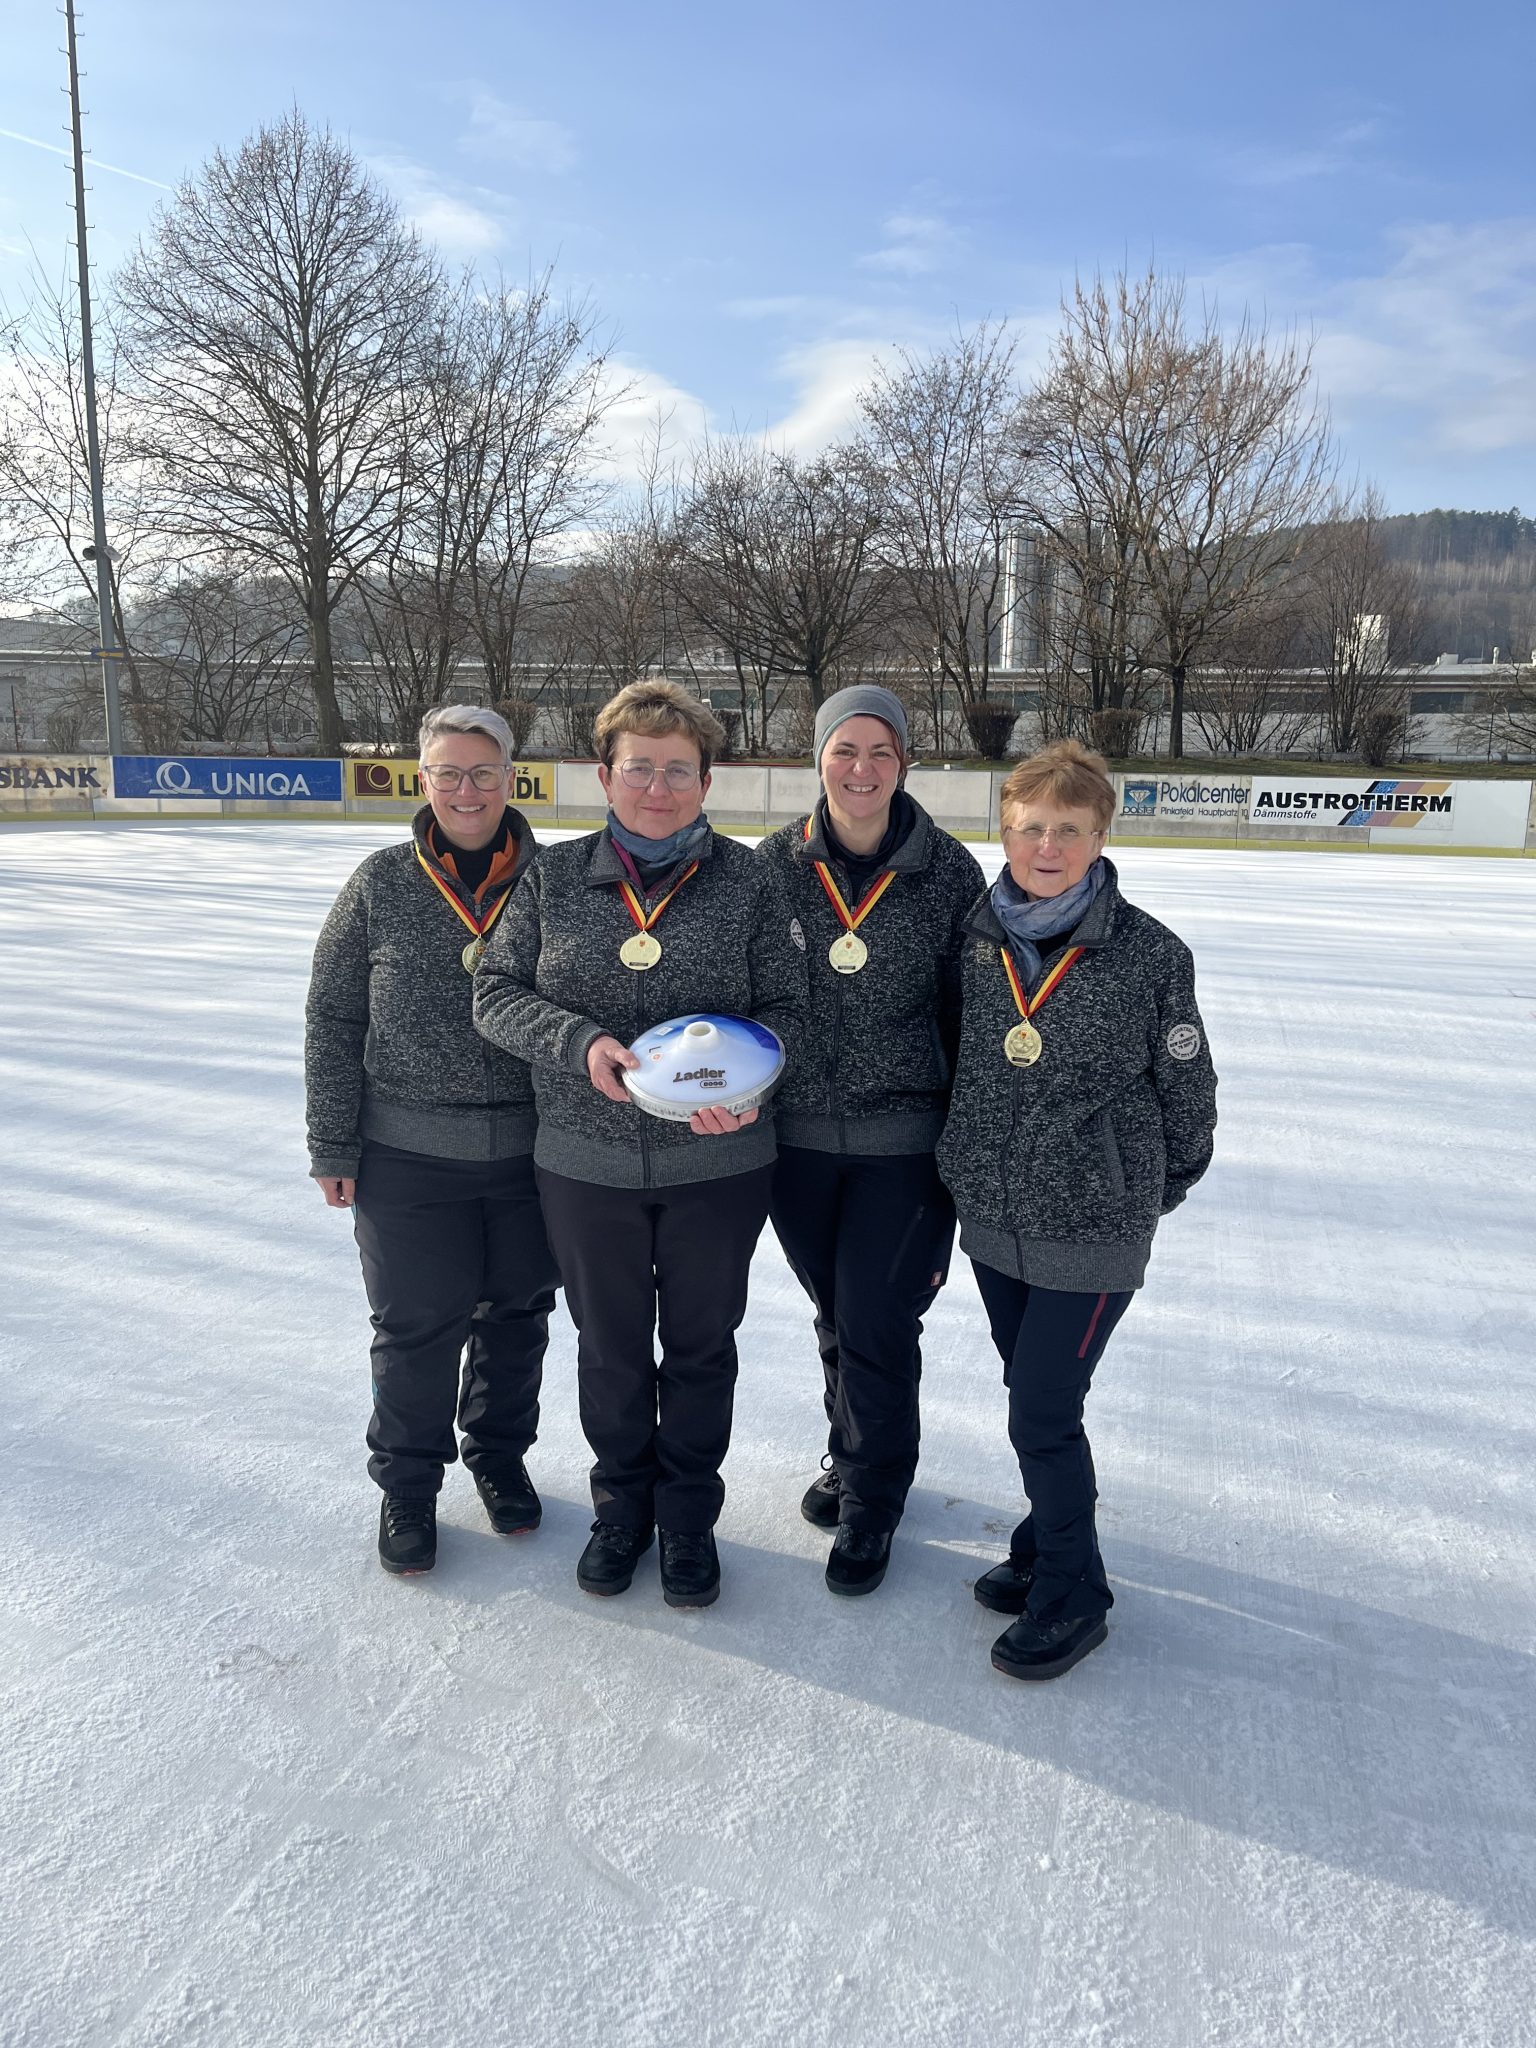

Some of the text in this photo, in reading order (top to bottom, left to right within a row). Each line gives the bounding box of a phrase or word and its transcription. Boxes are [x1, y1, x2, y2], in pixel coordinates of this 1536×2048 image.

[0, 767, 101, 788] SBANK
[212, 772, 311, 796] UNIQA
[1160, 782, 1251, 804] Pokalcenter
[1256, 791, 1452, 813] AUSTROTHERM
[1160, 806, 1194, 816] Pinkafeld
[1198, 807, 1238, 817] Hauptplatz
[1253, 808, 1317, 819] Dämmstoffe
[673, 1068, 725, 1082] Ladler
